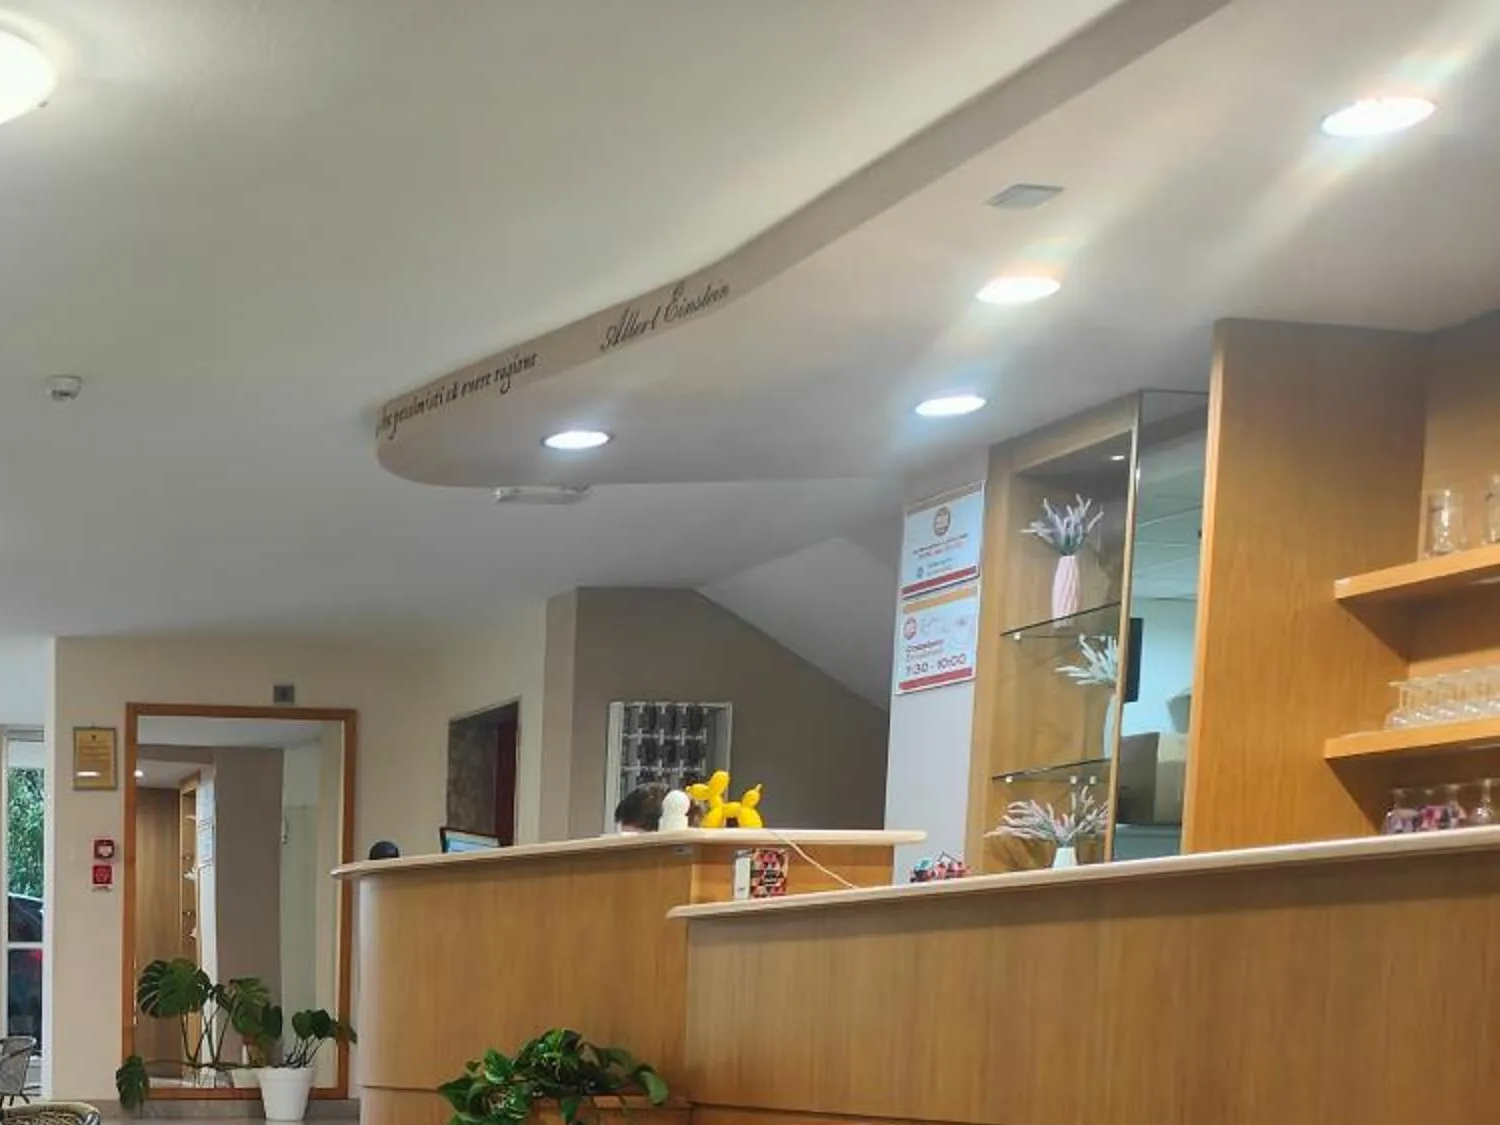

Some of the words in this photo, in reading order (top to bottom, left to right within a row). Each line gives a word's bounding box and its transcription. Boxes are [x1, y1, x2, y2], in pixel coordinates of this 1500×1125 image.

[600, 305, 662, 353] Albert
[663, 278, 730, 323] Einstein
[936, 652, 967, 671] 10:00
